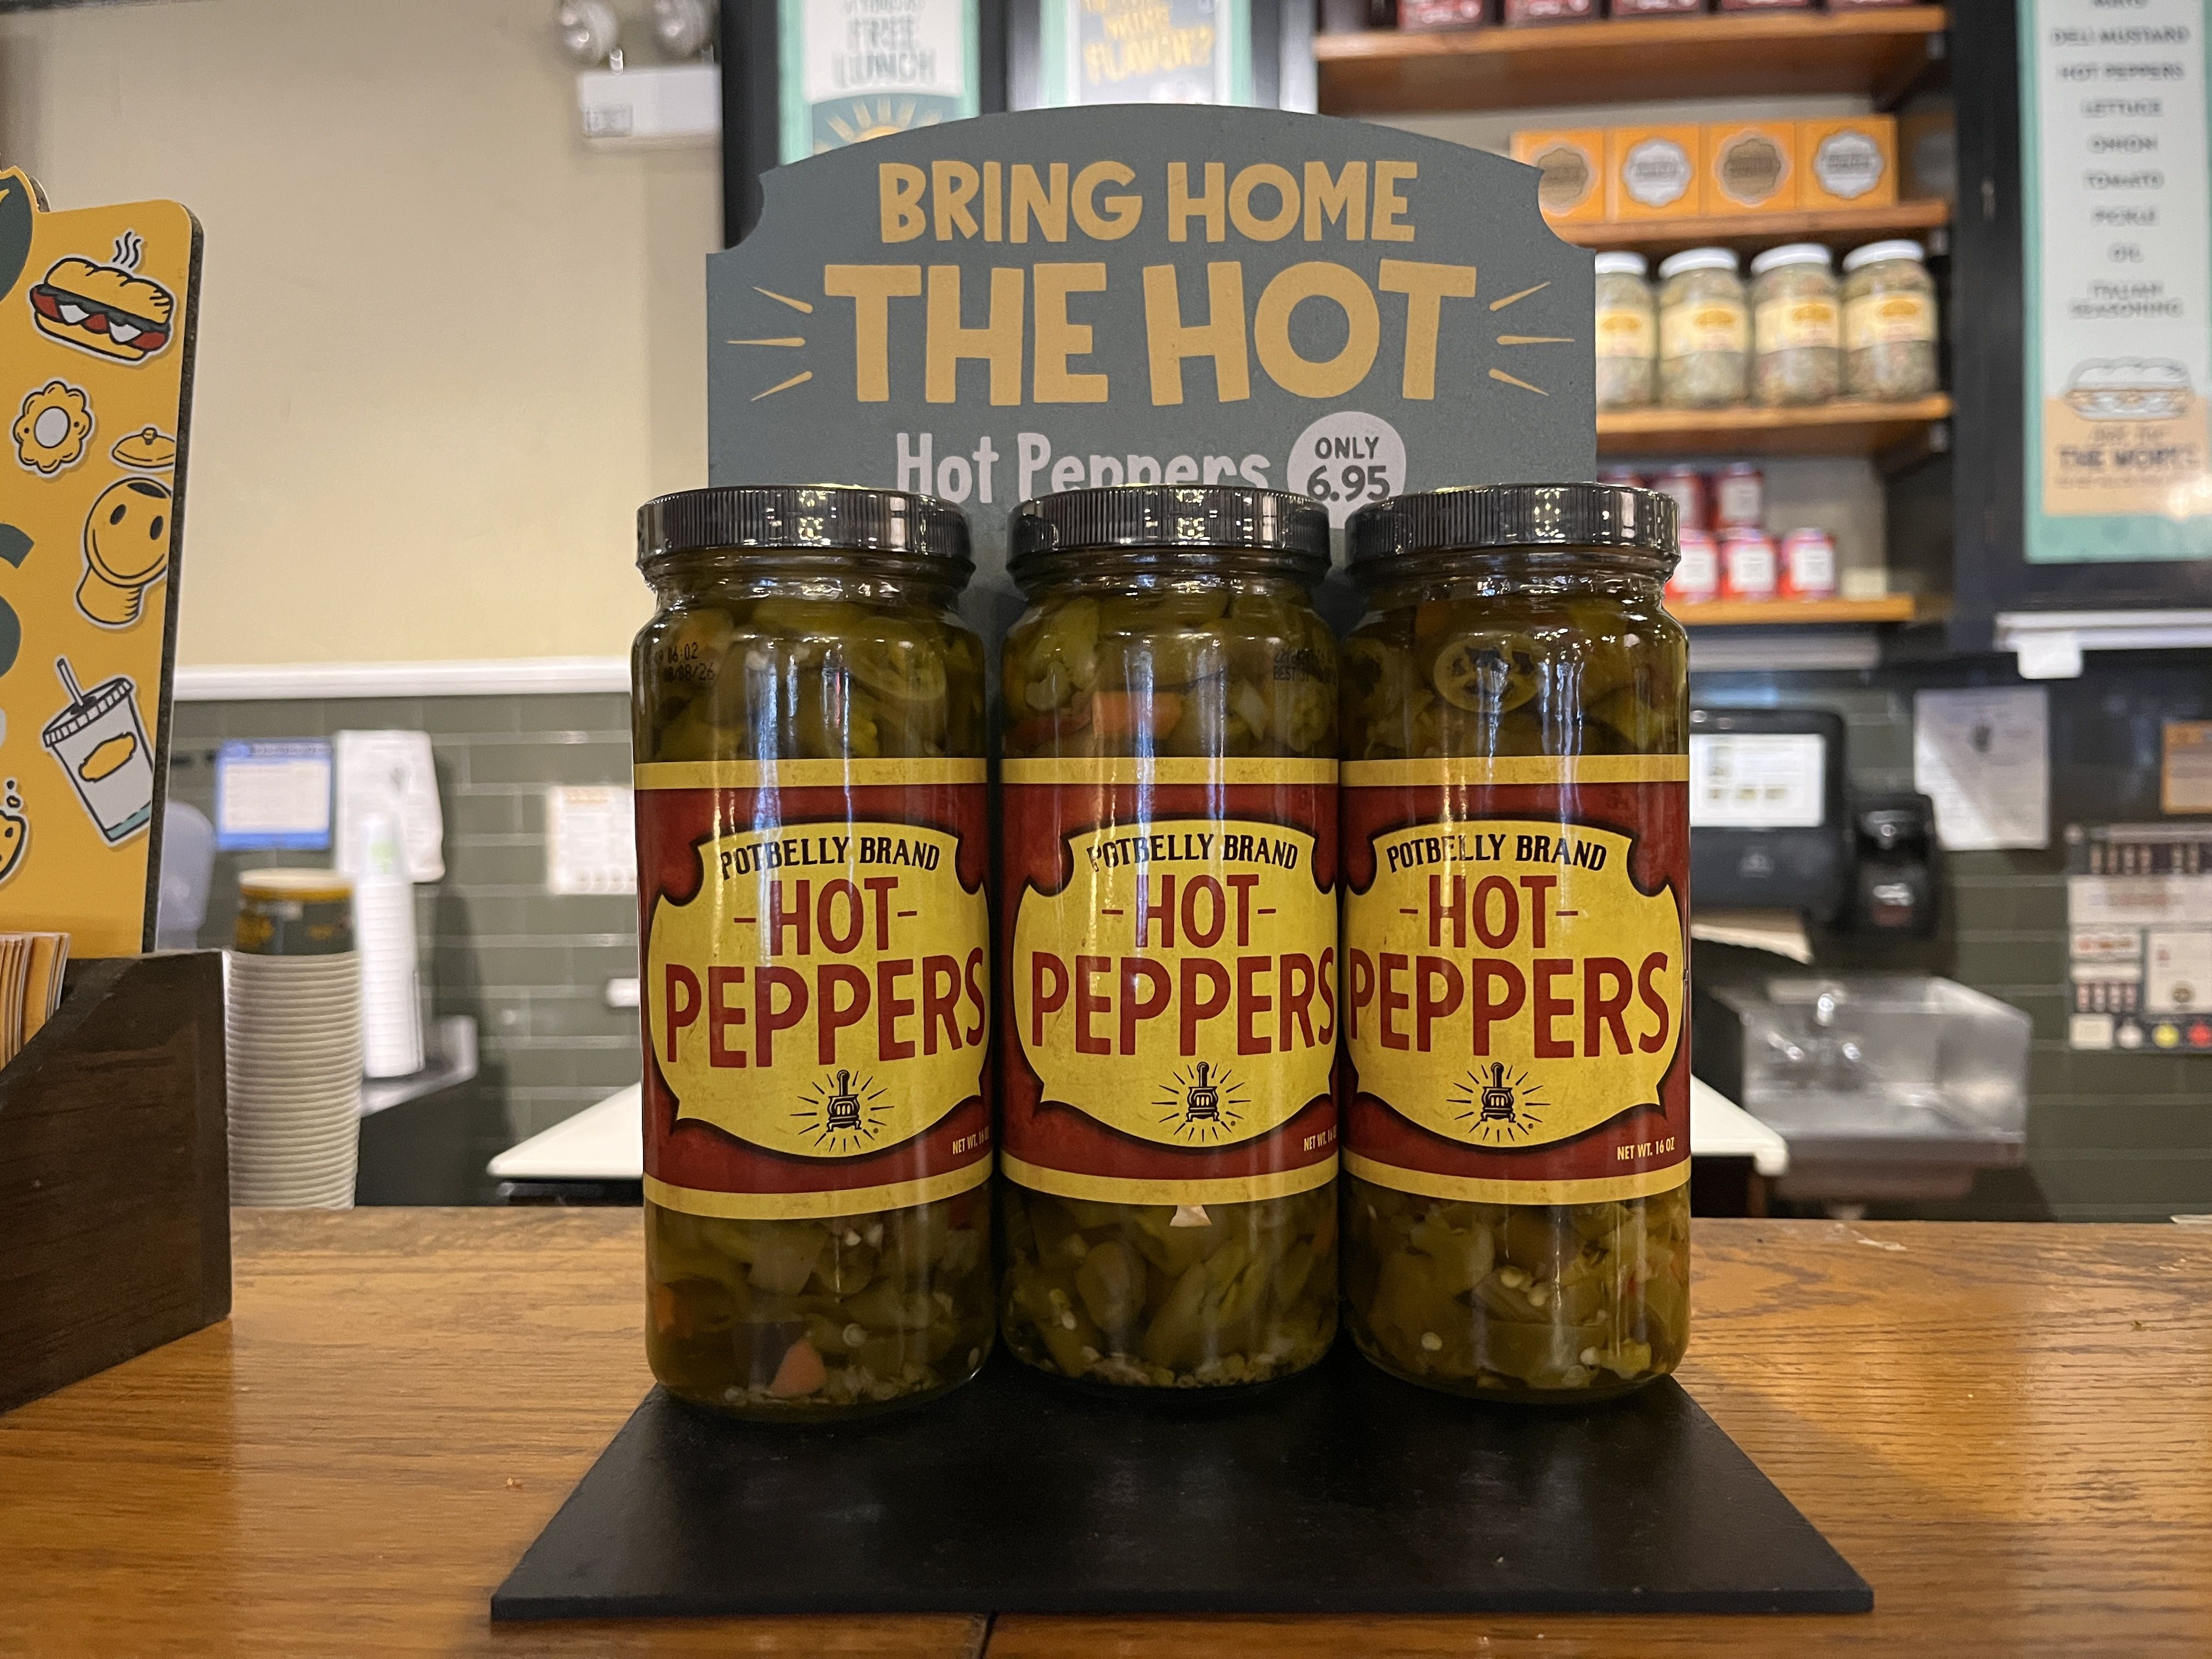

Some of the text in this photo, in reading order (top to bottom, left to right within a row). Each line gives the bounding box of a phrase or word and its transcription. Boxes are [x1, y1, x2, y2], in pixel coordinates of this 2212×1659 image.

[878, 160, 1418, 244] BRING HOME
[824, 258, 1477, 406] THE HOT
[895, 431, 998, 504] Hot
[1306, 464, 1390, 503] 6.95
[1313, 437, 1379, 460] ONLY
[720, 836, 940, 881] POTBELLY BRAND
[1087, 833, 1299, 872] POTBELLY BRAND
[1387, 833, 1607, 873] POTBELLY BRAND
[770, 876, 899, 956] HOT
[1135, 873, 1260, 949] HOT
[1429, 874, 1557, 950] HOT
[665, 946, 986, 1069] PEPPERS
[1031, 946, 1335, 1056] PEPPERS
[1350, 947, 1670, 1060] PEPPERS
[952, 1138, 966, 1155] NET
[967, 1134, 978, 1150] WT.
[1304, 1135, 1316, 1152] NET
[1317, 1131, 1327, 1147] WT.
[1617, 1136, 1675, 1160] NET WT. 16 OZ
